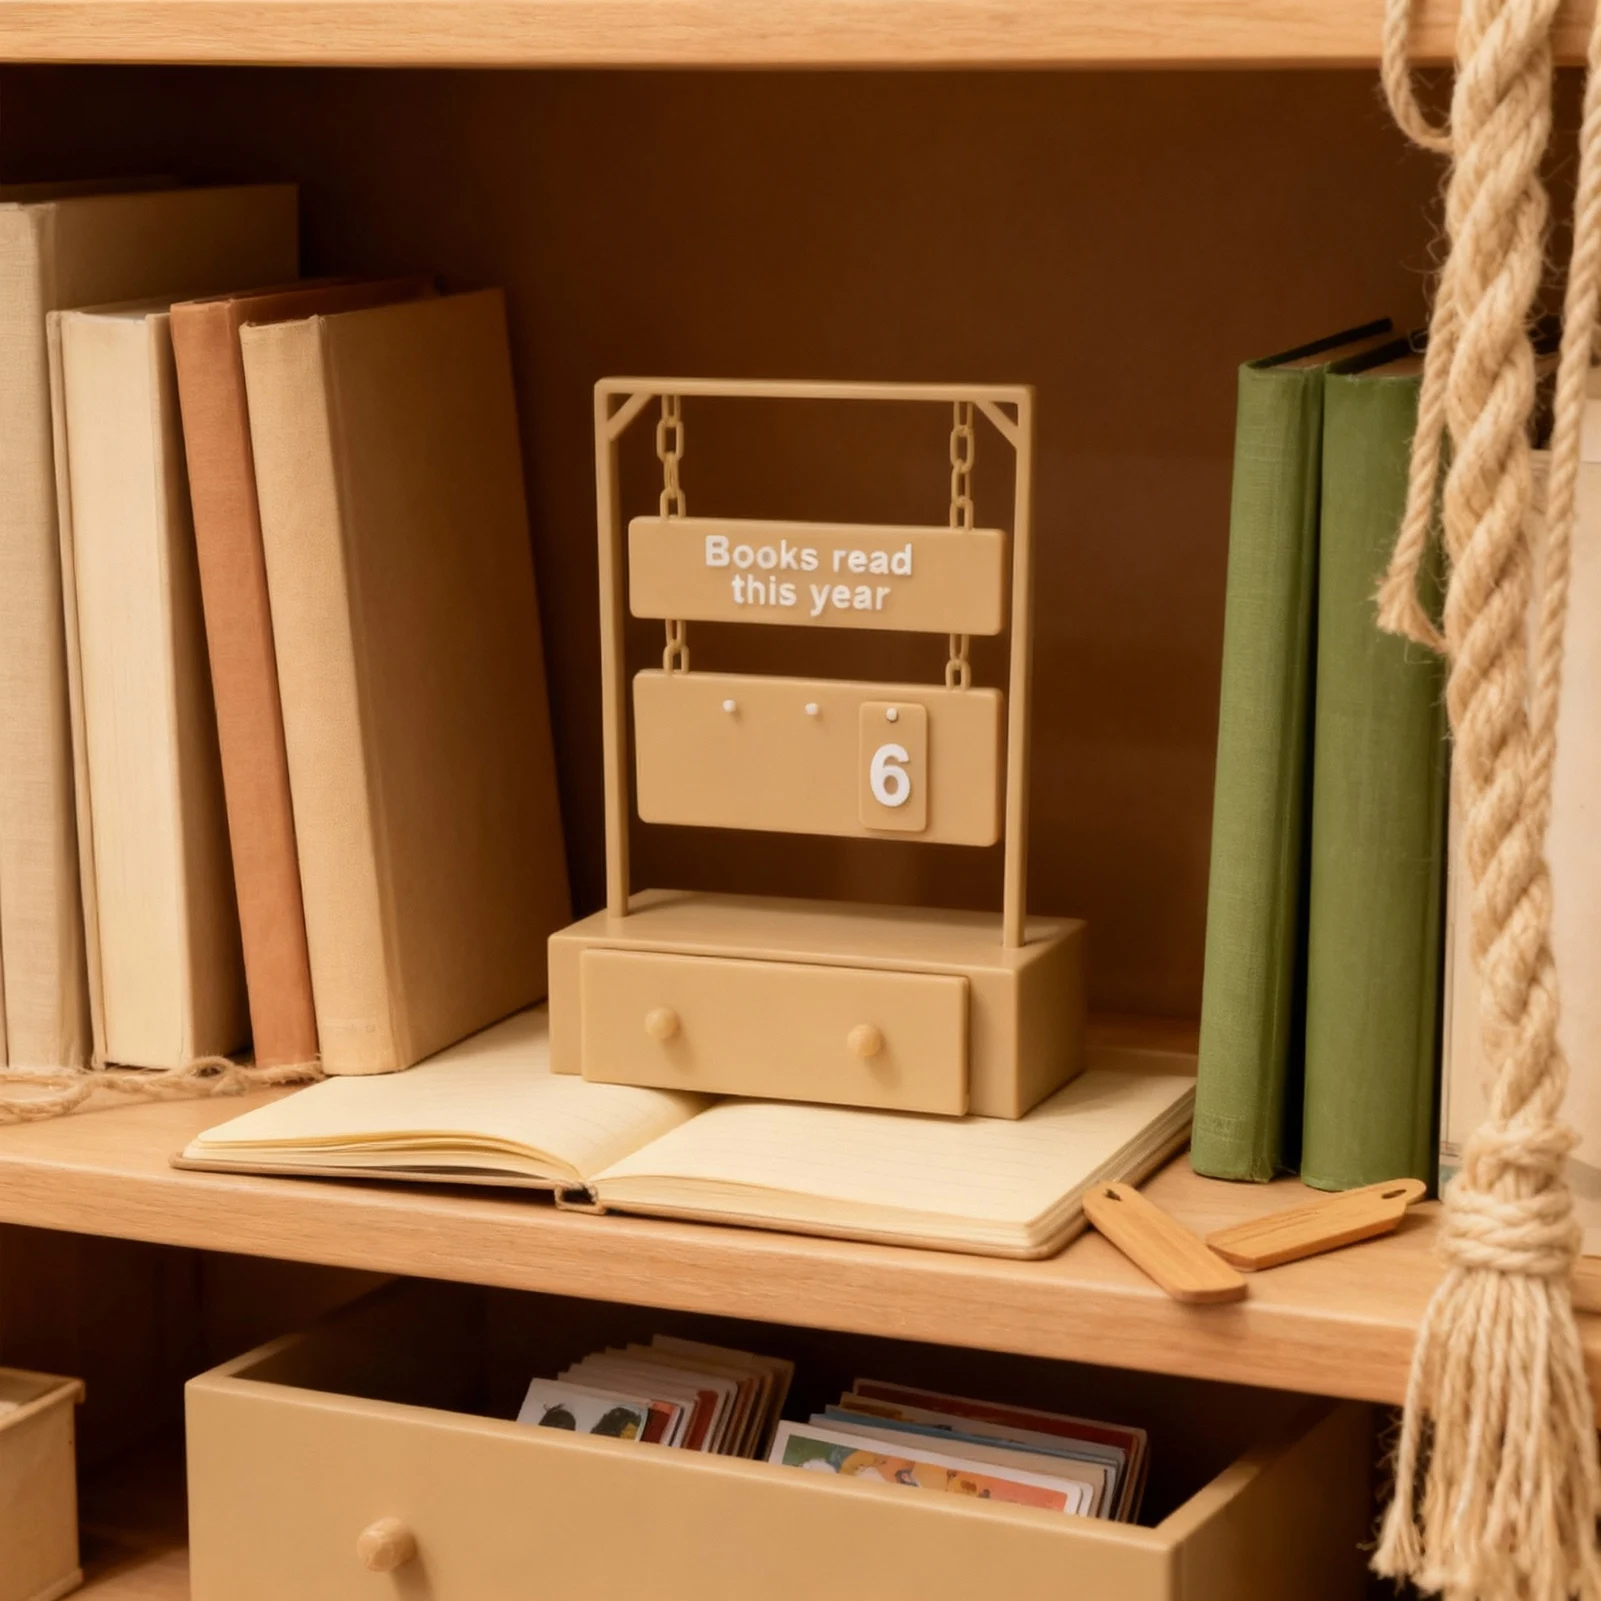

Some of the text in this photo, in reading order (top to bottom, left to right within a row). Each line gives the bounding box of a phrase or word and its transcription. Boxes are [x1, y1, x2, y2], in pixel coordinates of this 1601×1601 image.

[705, 535, 912, 575] Books read
[731, 574, 891, 617] this year
[869, 743, 911, 808] 6
